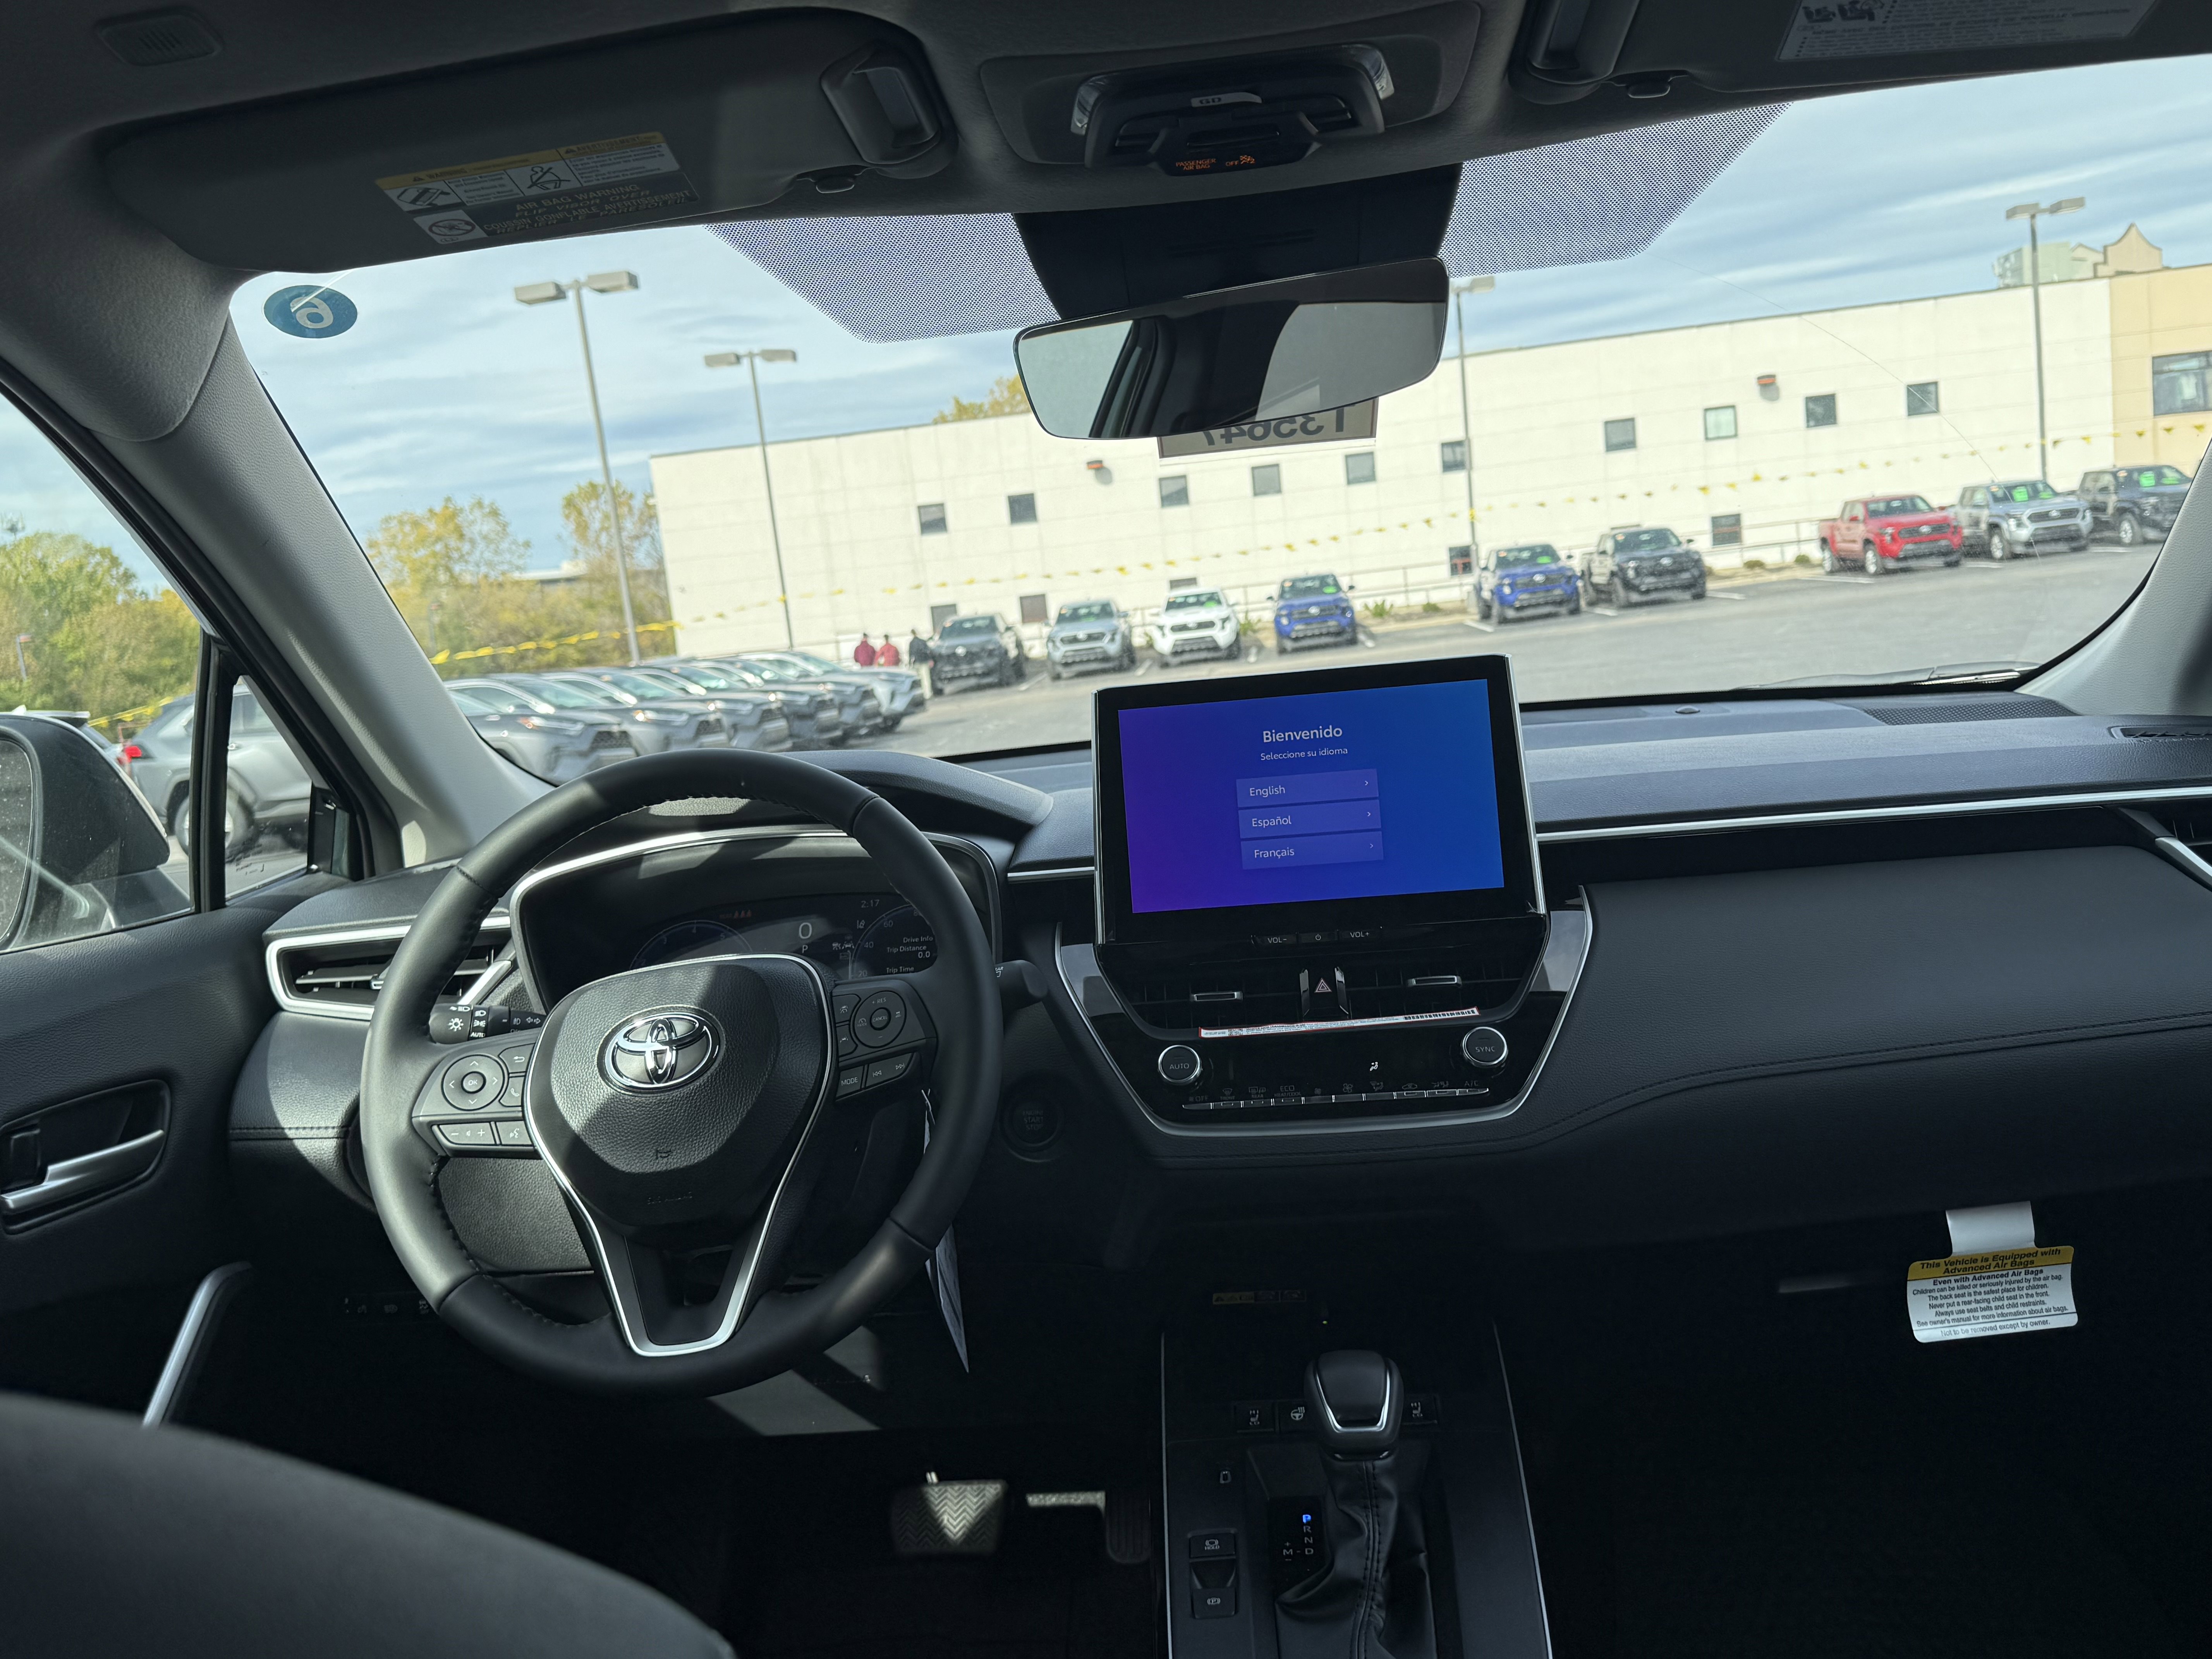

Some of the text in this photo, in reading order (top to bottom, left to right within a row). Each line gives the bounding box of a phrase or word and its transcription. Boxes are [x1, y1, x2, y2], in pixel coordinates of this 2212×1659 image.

[1176, 158, 1217, 167] PASSENGER
[516, 185, 639, 210] AIR BAG WARNING
[515, 191, 649, 217] FLIP VISOR OVER
[483, 190, 690, 230] COUSSIN GONFLABLE AVERTISSEMENT
[1262, 725, 1343, 743] Bienvenido
[1261, 750, 1305, 761] Seleccione
[1319, 746, 1348, 756] idioma
[1249, 784, 1285, 797] English
[1252, 815, 1292, 829] Español
[1254, 847, 1295, 859] Français
[861, 899, 879, 908] 2:17
[799, 922, 812, 939] 0
[802, 945, 808, 953] P
[858, 970, 867, 978] 20
[1475, 1045, 1496, 1053] SYNC
[1169, 1062, 1190, 1070] AUTO
[841, 1077, 858, 1086] MODE
[1944, 1257, 1978, 1267] Vehicle
[1992, 1250, 2038, 1262] Equipped
[1943, 1263, 1991, 1274] Advanced
[1972, 1271, 2009, 1281] Advanced
[1961, 1297, 1990, 1306] rear-facing
[1996, 1310, 2027, 1318] information
[1971, 1325, 1997, 1333] removed
[1302, 1514, 1312, 1524] P
[1304, 1536, 1313, 1544] N
